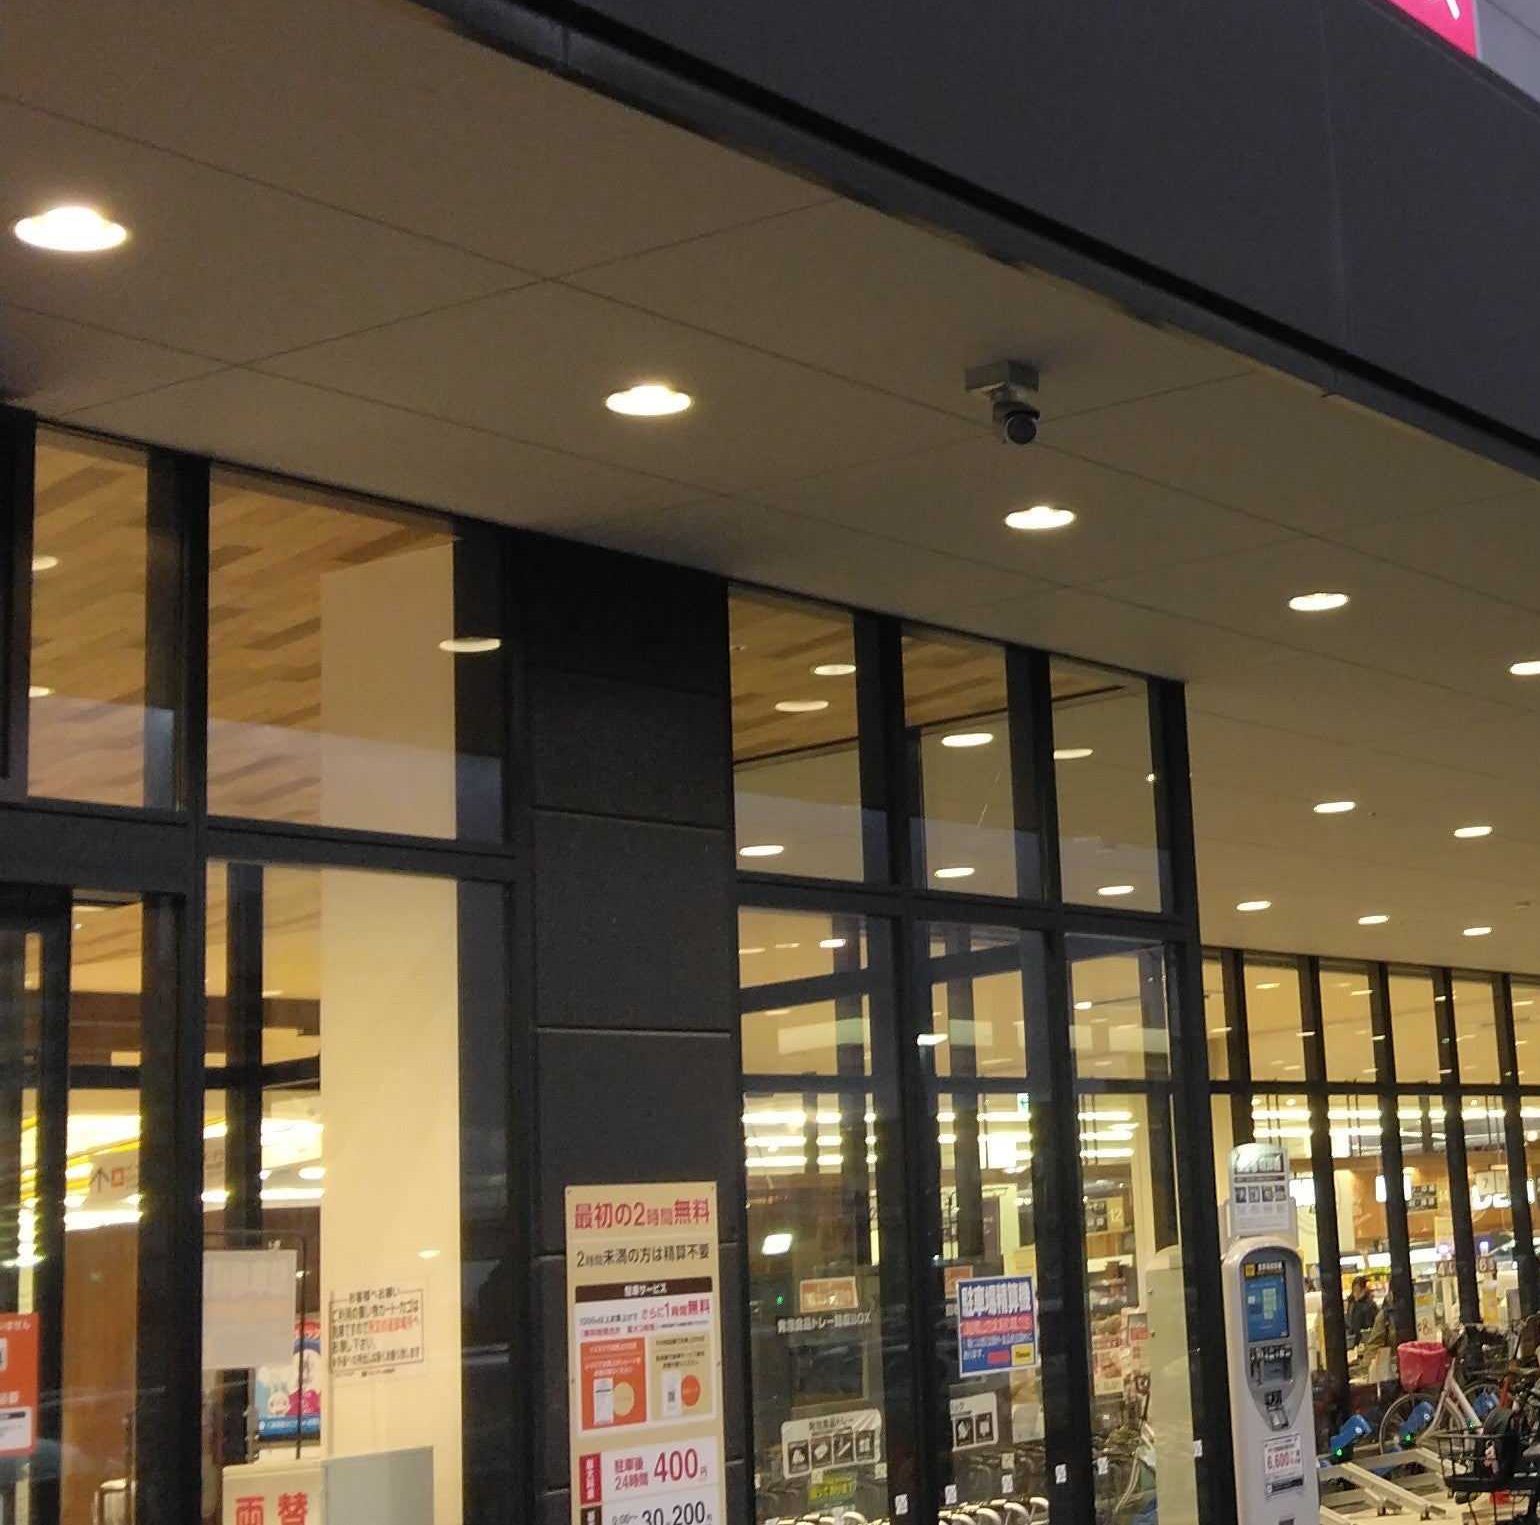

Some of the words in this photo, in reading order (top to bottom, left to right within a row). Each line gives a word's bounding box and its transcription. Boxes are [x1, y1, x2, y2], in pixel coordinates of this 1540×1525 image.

[575, 1198, 710, 1230] 最初の2時間無料
